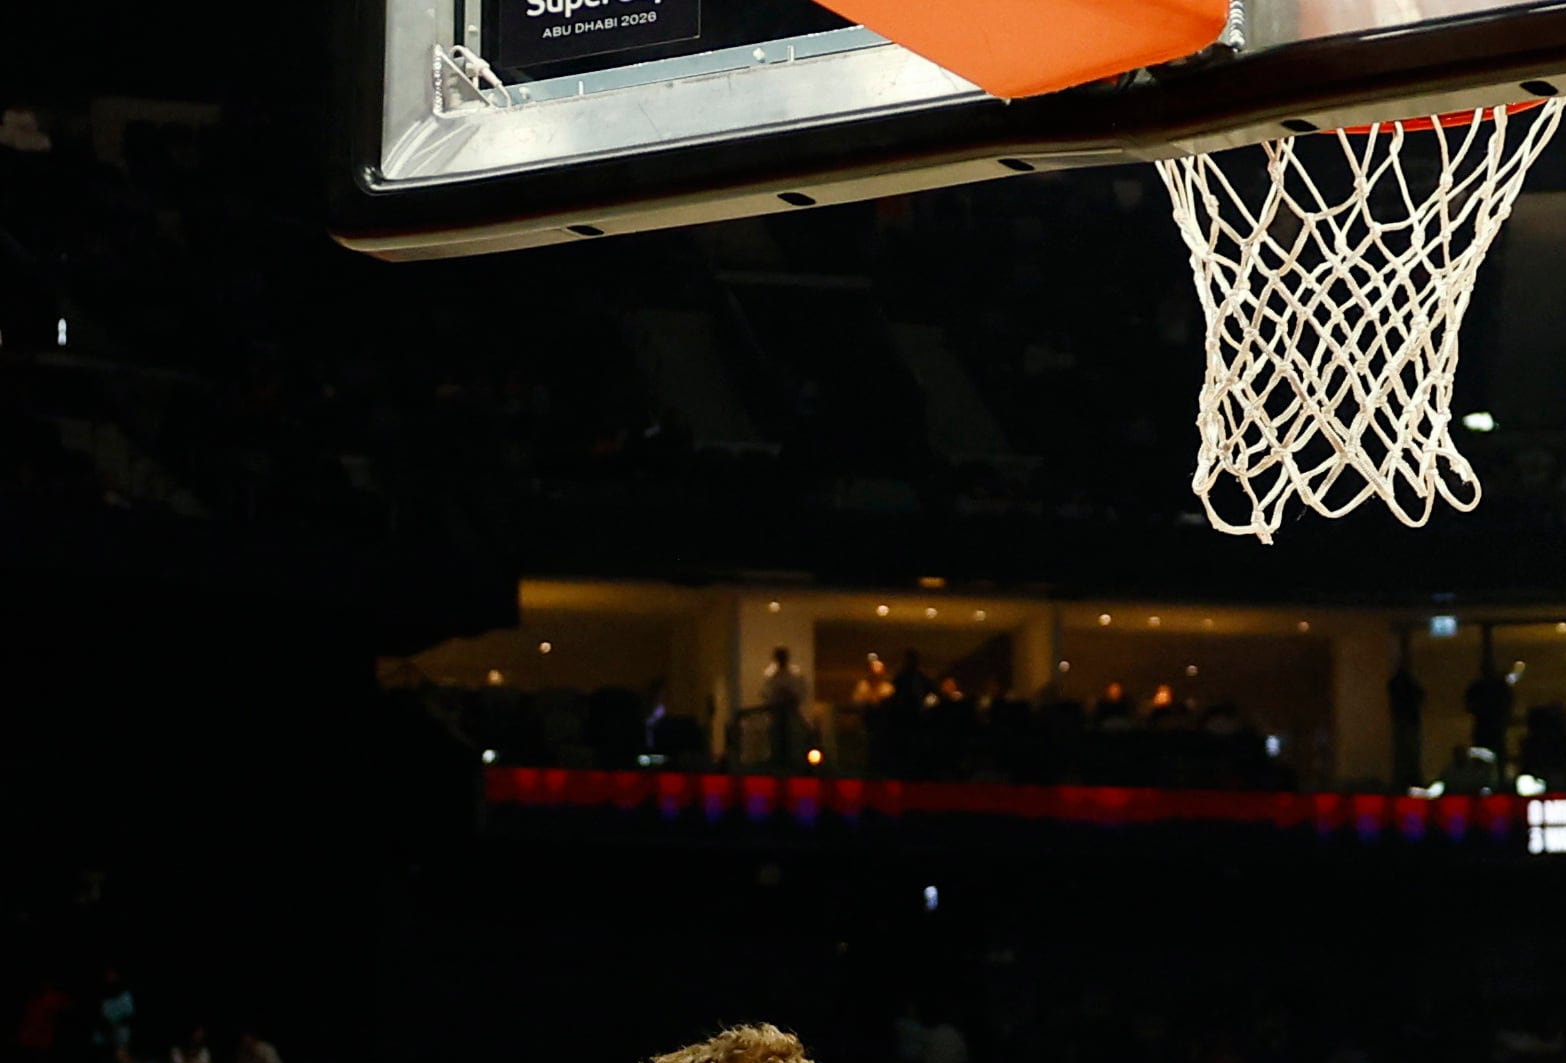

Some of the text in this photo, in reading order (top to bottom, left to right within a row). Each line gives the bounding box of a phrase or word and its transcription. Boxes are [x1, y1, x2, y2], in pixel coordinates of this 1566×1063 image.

[542, 11, 657, 38] ABU DHABI 2026
